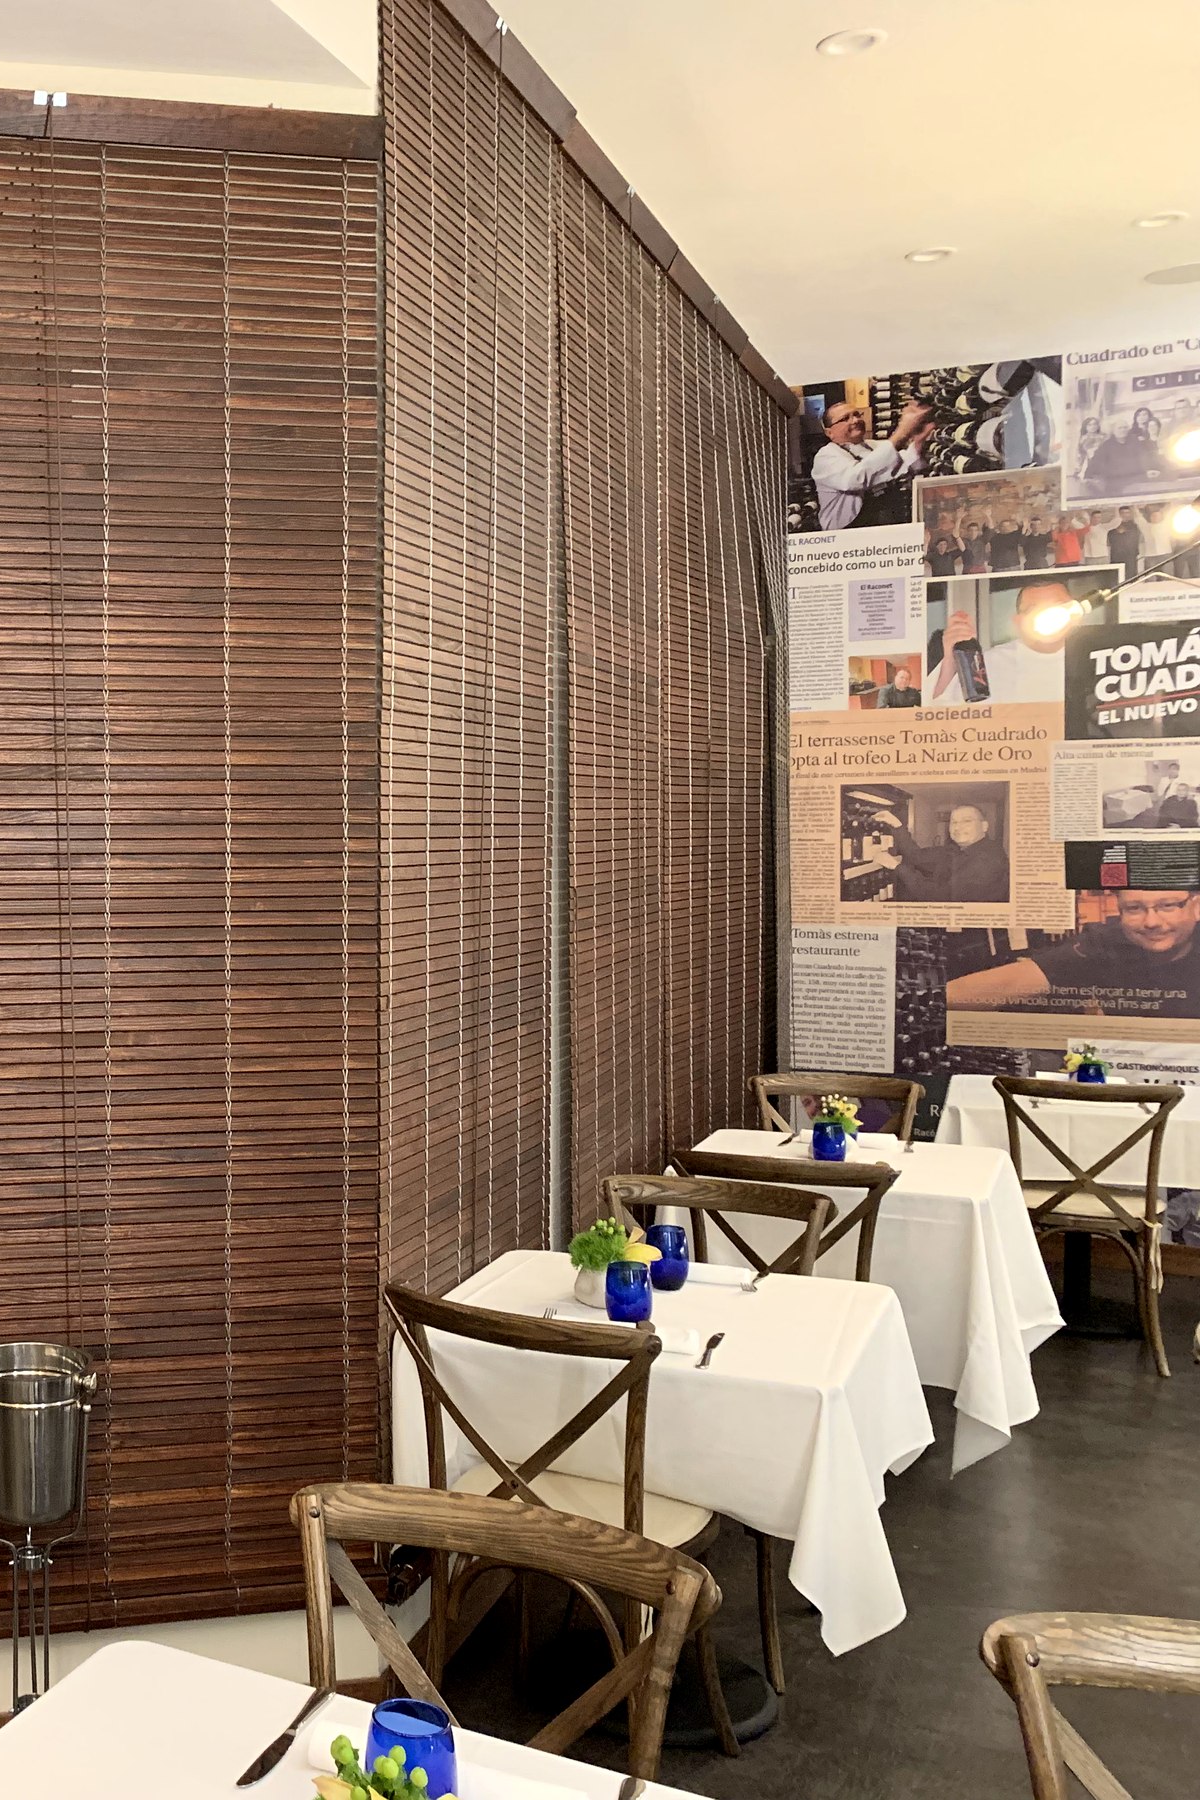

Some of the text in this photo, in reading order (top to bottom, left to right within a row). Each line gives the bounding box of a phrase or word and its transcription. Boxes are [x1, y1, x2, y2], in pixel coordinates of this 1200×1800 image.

[1066, 345, 1149, 365] Cuadrado
[1152, 343, 1173, 355] en
[788, 535, 836, 546] EL RACONET
[788, 543, 924, 563] Un nuevo establecimient
[788, 562, 843, 575] concebido
[845, 561, 877, 571] como
[879, 559, 894, 568] un
[897, 556, 916, 567] bar
[867, 583, 893, 591] Raconet
[1090, 626, 1200, 676] TOMÁ
[1095, 663, 1200, 702] CUAD
[915, 706, 993, 721] sociedad
[1098, 697, 1198, 725] EL NUEVO
[789, 726, 1048, 748] El terrassense Tomàs Cuadrado
[790, 746, 1032, 770] opta al trofeo La Nariz de Oro
[1105, 750, 1118, 758] de
[791, 928, 879, 941] Tomàs estrena
[792, 946, 861, 957] restaurante
[1052, 985, 1078, 994] hem
[1080, 985, 1124, 998] esforçat
[1135, 988, 1162, 997] tenir
[1164, 990, 1187, 998] una
[1051, 998, 1116, 1008] competitiva
[1118, 998, 1139, 1010] fins
[1116, 1062, 1200, 1073] GASTRONÒMIQUES
[913, 1127, 936, 1137] Racó
